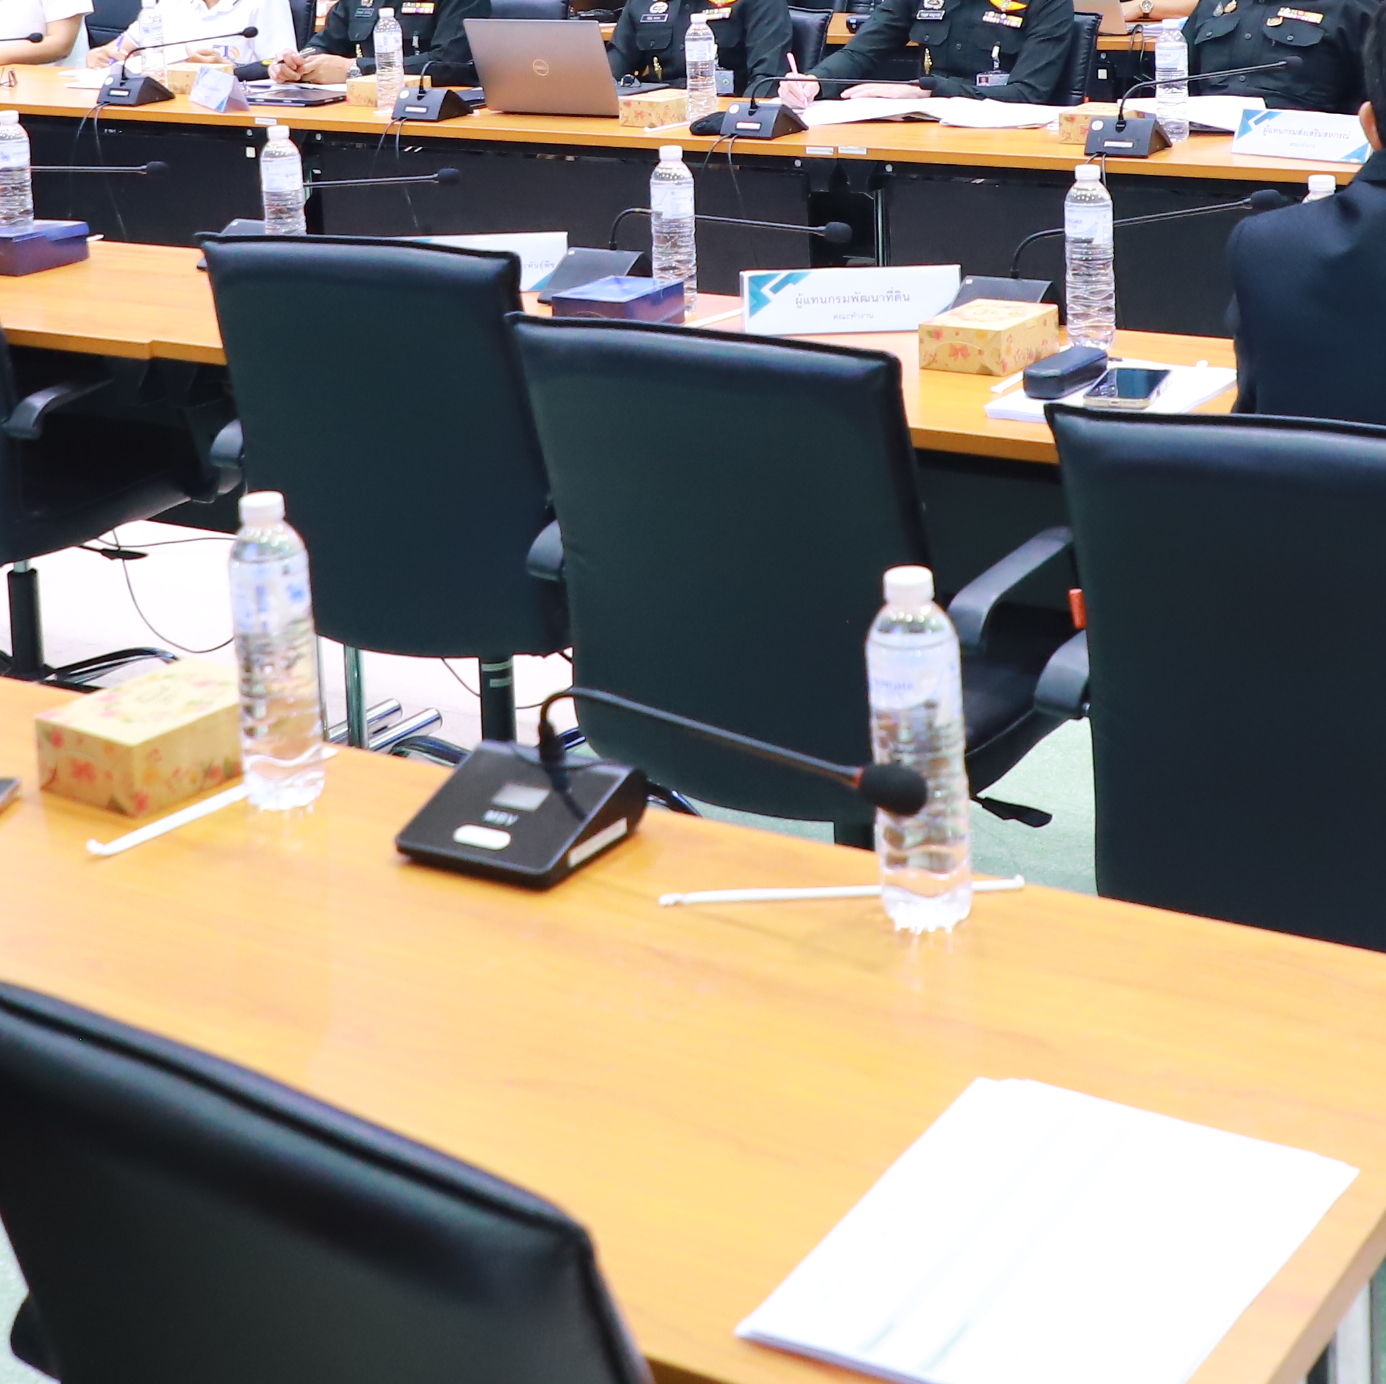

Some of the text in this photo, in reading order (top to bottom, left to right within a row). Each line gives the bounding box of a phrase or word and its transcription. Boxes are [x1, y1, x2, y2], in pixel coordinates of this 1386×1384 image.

[795, 287, 911, 309] ผู้แทนกรมพัฒนาที่ดิน
